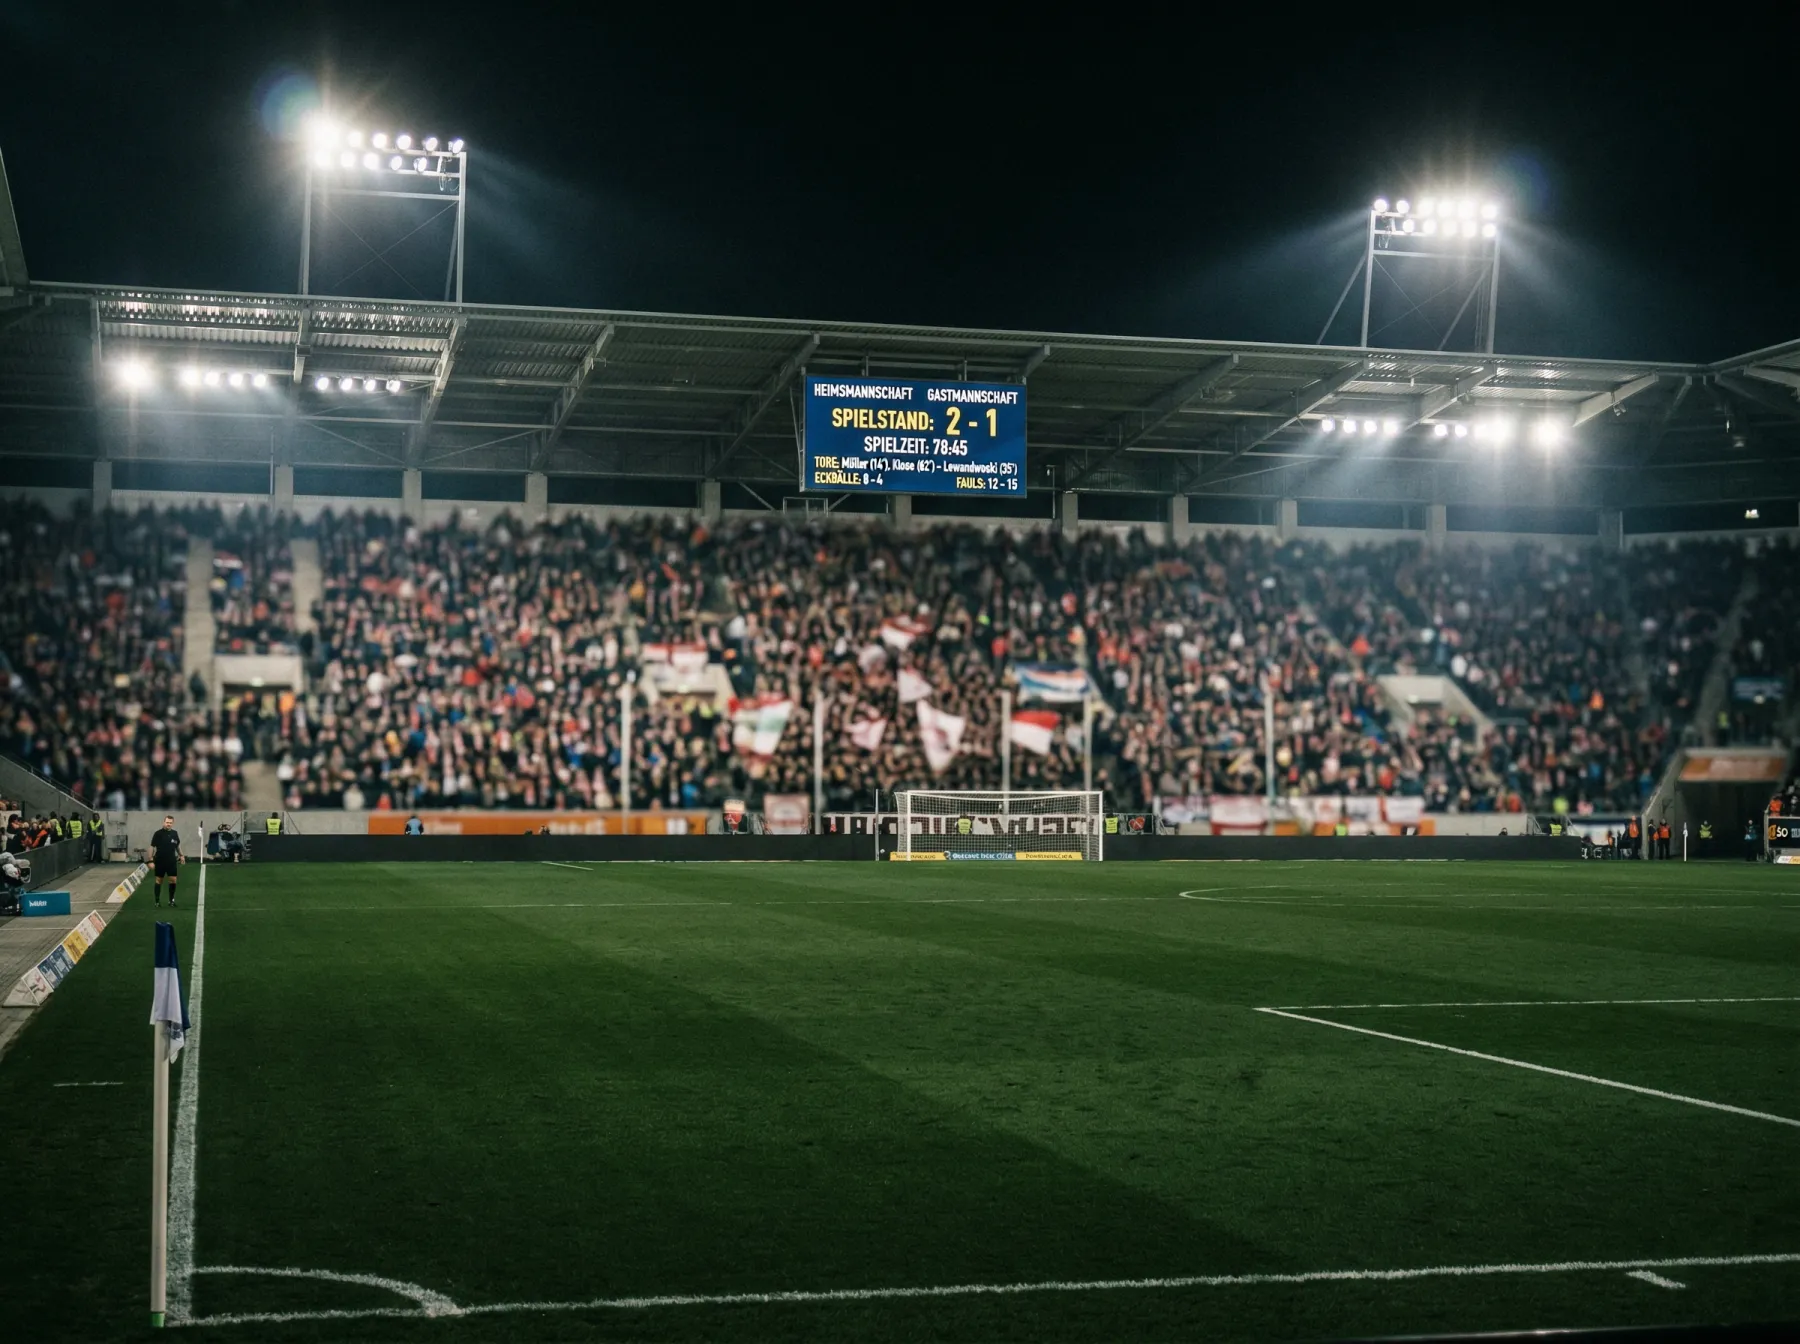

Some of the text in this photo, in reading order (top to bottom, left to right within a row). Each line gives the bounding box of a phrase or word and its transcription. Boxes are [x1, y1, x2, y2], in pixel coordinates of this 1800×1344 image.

[814, 383, 1018, 404] HEIMSMANNSCHAFT GASTMANNSCHAFT
[832, 407, 934, 430] SPIELSTAND:
[946, 406, 961, 436] 2
[986, 408, 997, 437] 1
[864, 436, 968, 456] SPIELZEIT: 78:45
[814, 456, 839, 468] TORE:
[892, 459, 914, 470] Klose
[815, 470, 861, 484] ECKBÄLLE:
[863, 474, 869, 485] 8
[876, 474, 883, 485] 4
[957, 477, 986, 489] FAULS:
[988, 478, 998, 489] 12
[1007, 479, 1017, 490] 15
